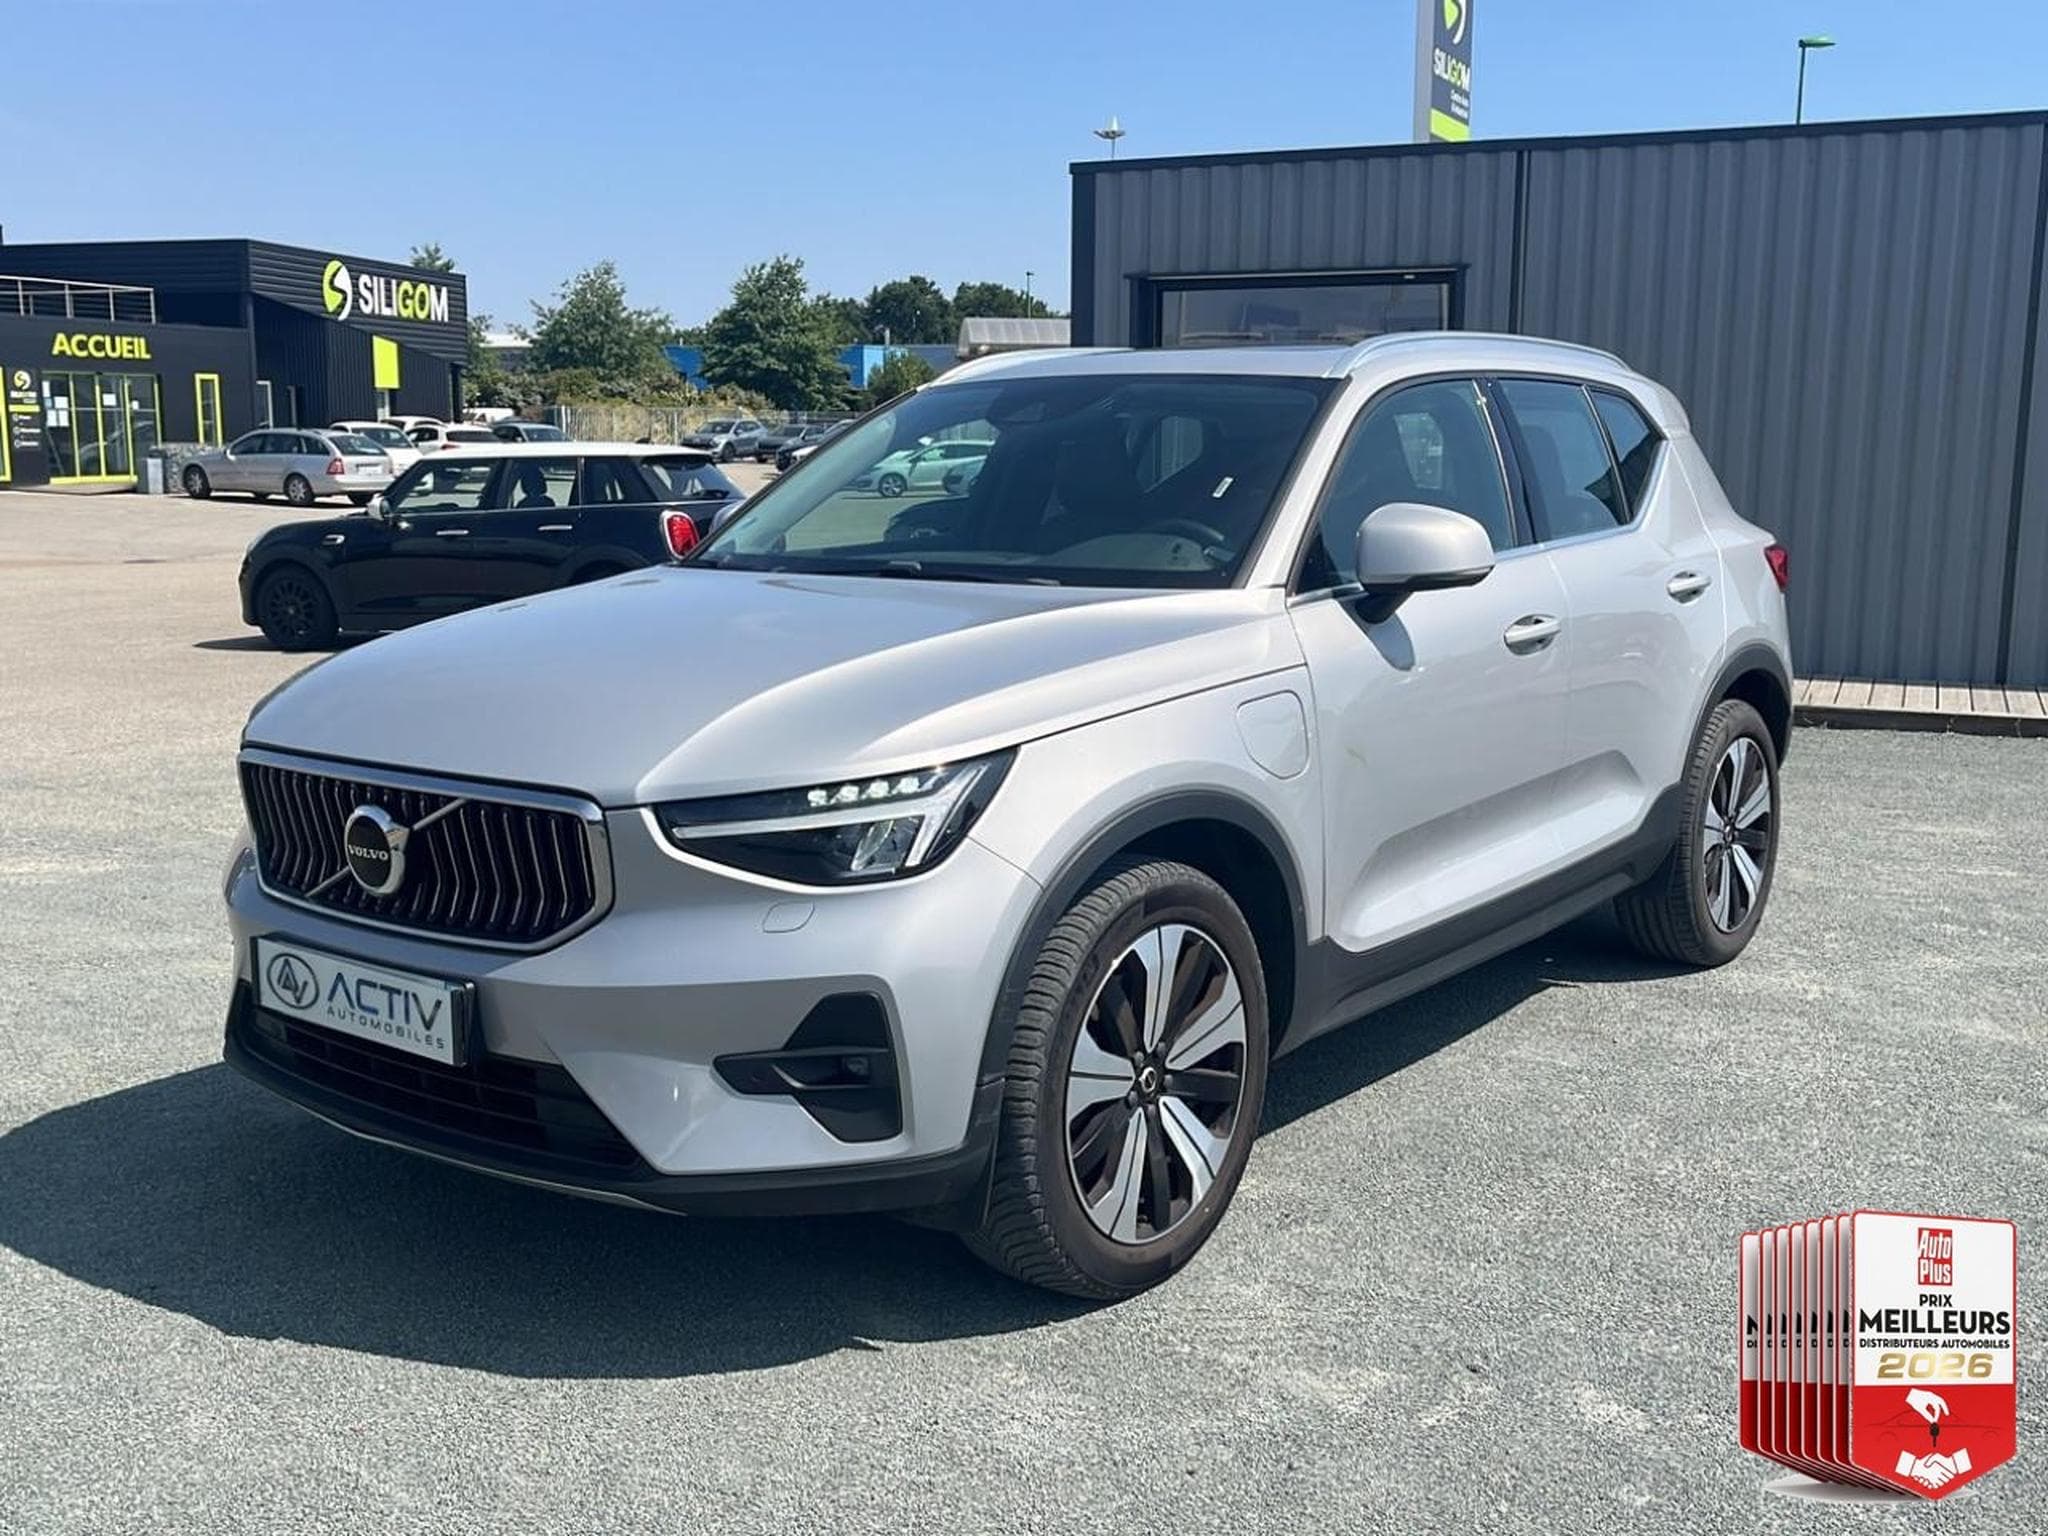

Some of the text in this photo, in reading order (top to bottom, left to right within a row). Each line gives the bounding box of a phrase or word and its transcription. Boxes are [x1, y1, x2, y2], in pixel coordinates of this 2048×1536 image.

[358, 273, 449, 322] SILIGOM
[52, 332, 152, 360] ACCUEIL
[348, 844, 389, 861] VOLVO
[327, 972, 442, 1031] ACTIV
[327, 1004, 446, 1050] AUTOMOBILES
